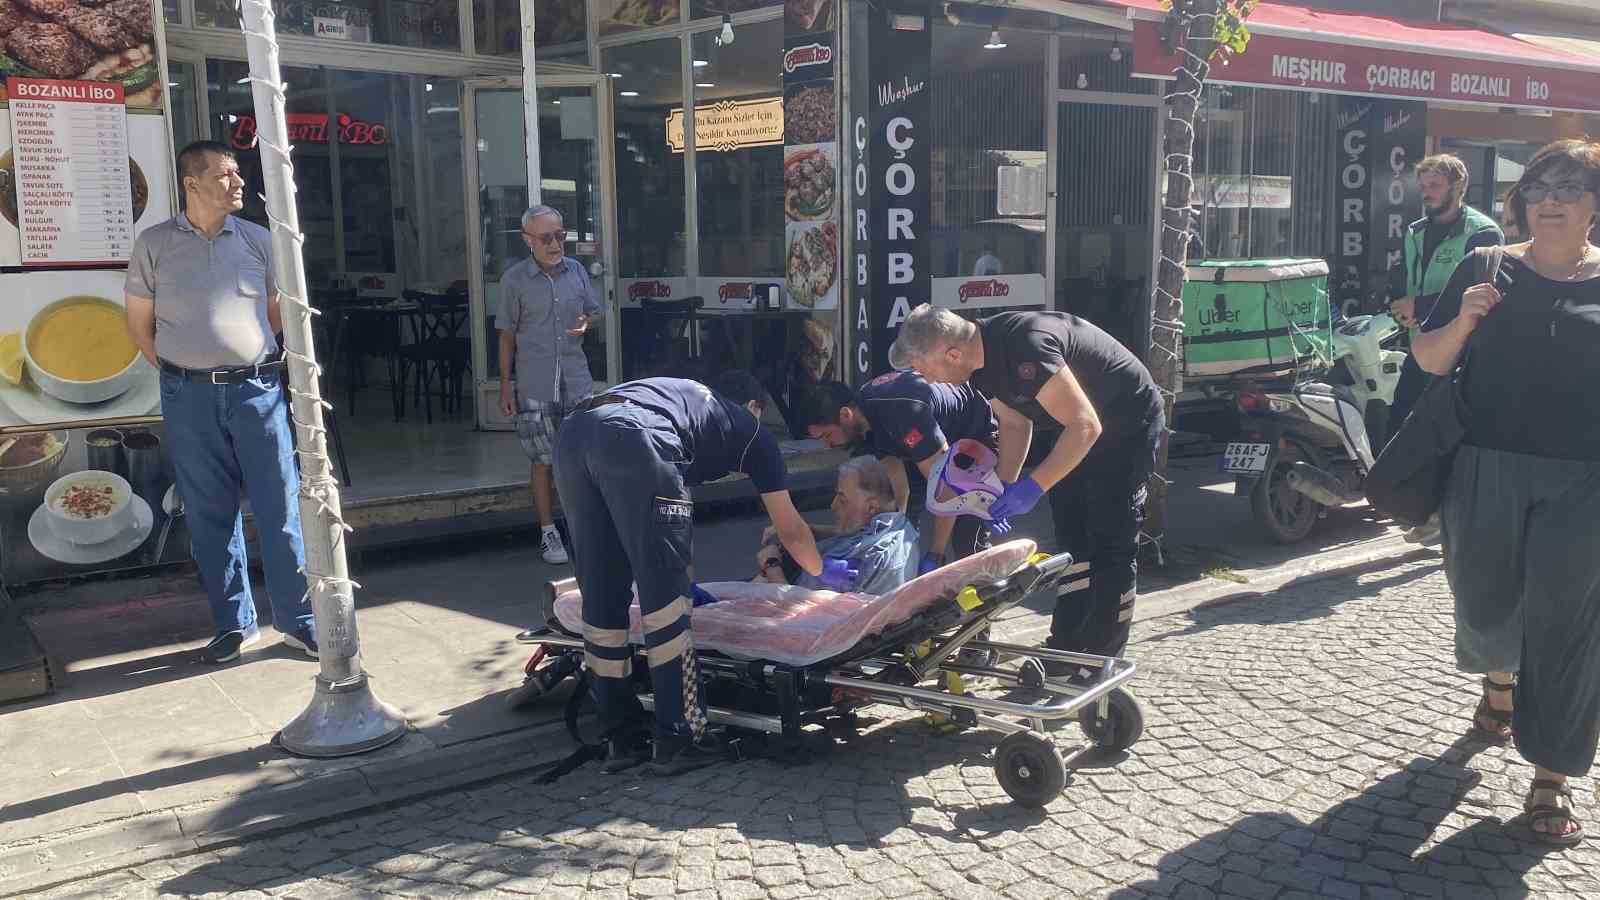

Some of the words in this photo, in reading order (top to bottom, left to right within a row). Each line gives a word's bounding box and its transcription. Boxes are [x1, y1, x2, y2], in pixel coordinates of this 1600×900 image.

[17, 83, 86, 98] BOZANLI
[89, 85, 116, 100] İBO
[1271, 54, 1347, 86] MEŞHUR
[1366, 63, 1436, 91] ÇORBACI
[1451, 73, 1511, 97] BOZANLI
[1526, 75, 1549, 100] İBO
[856, 116, 868, 372] ÇORBAC
[1231, 457, 1256, 469] 247
